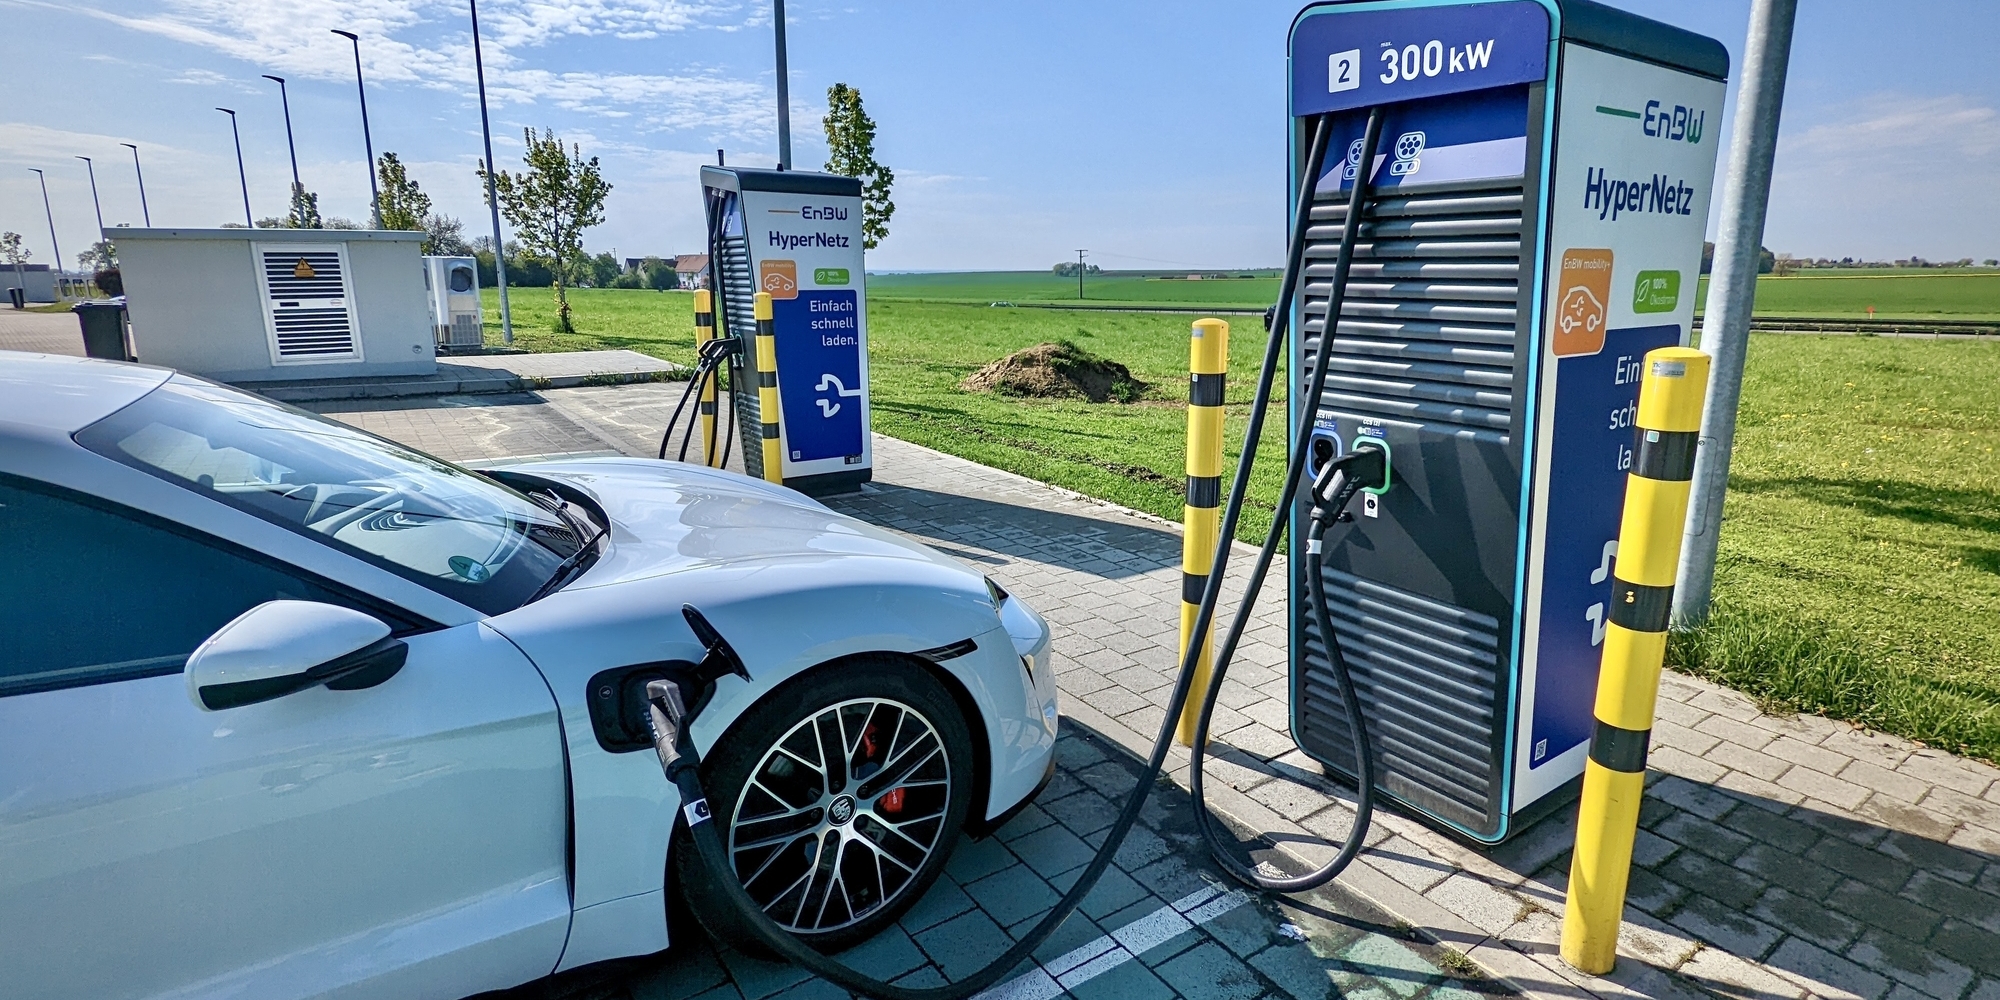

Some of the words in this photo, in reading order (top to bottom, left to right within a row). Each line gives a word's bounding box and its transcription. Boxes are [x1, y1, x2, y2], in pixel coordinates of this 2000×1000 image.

[1379, 39, 1443, 85] 300
[1449, 39, 1495, 74] kW
[1338, 59, 1350, 84] 2
[1643, 99, 1705, 144] EnBW
[1584, 166, 1694, 221] HyperNetz
[802, 205, 848, 221] EnBW
[769, 230, 849, 251] HyperNetz
[1563, 258, 1583, 270] EnBW
[810, 300, 853, 312] Einfach
[811, 316, 854, 329] schnell
[822, 335, 858, 346] laden.
